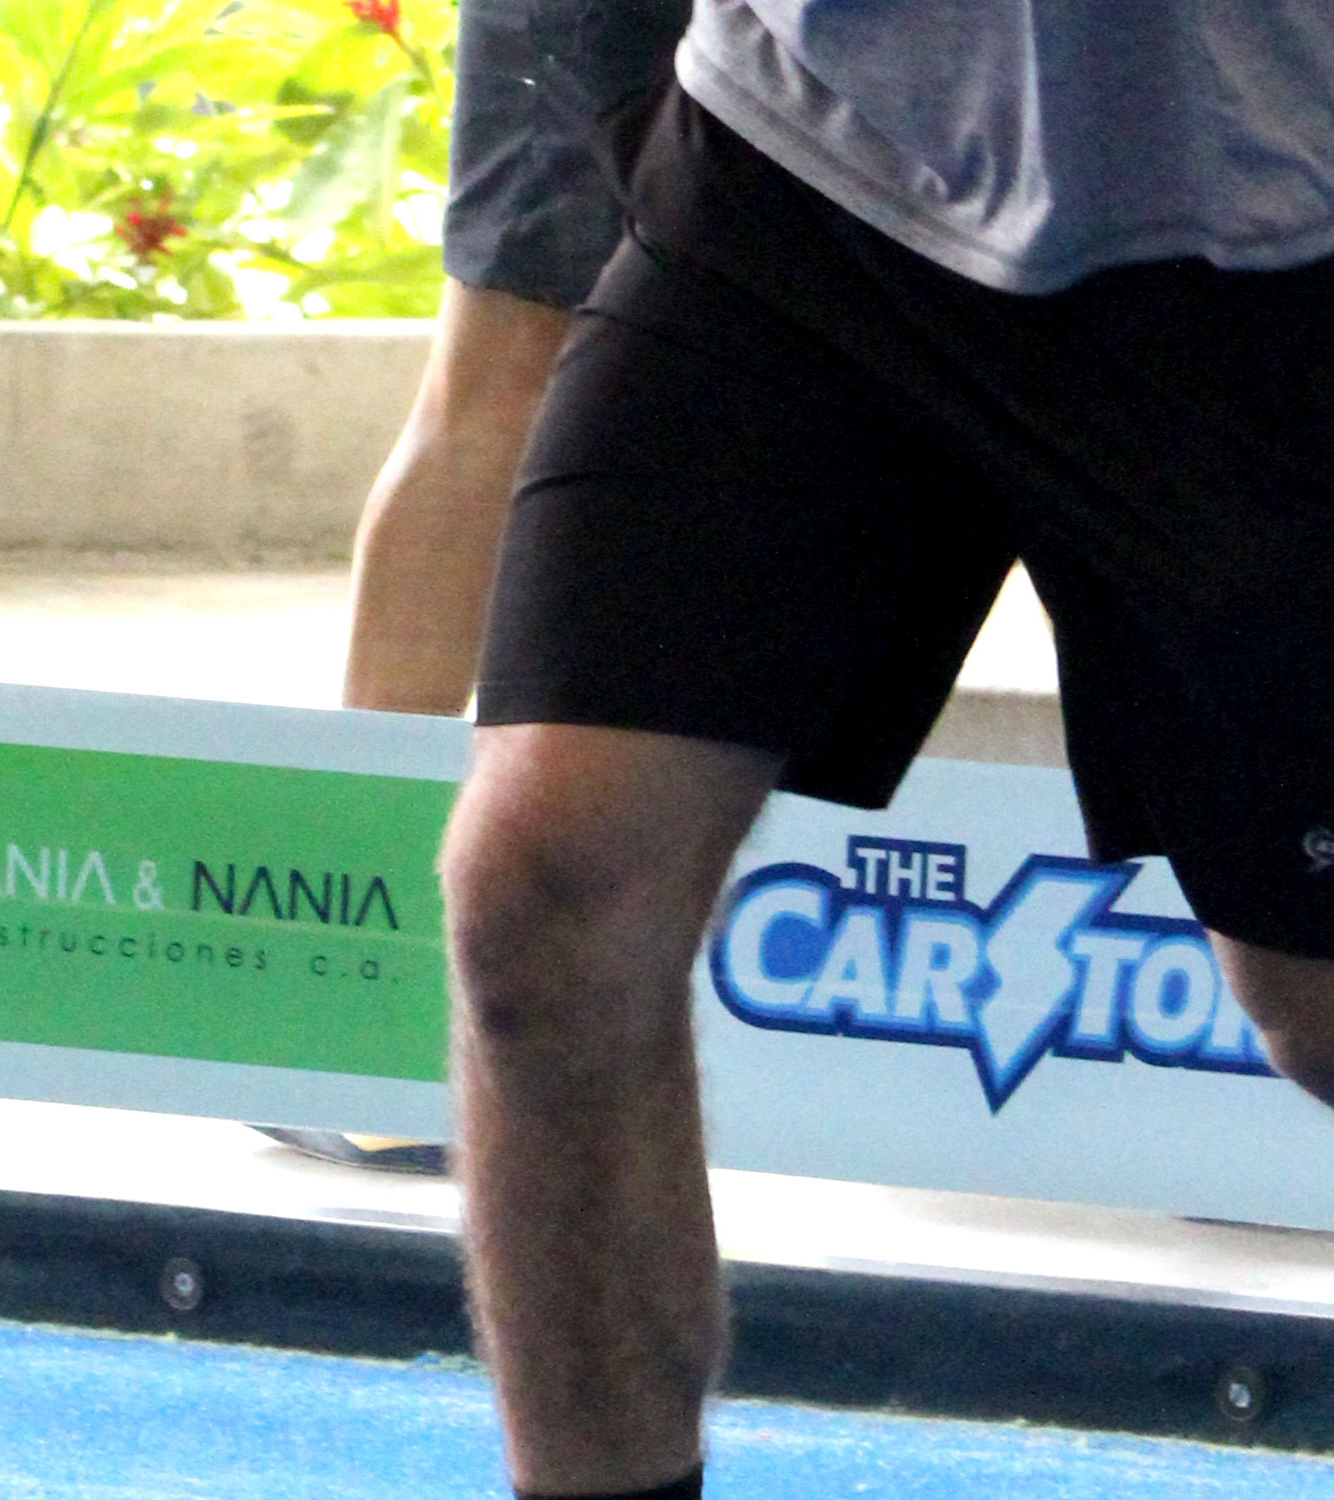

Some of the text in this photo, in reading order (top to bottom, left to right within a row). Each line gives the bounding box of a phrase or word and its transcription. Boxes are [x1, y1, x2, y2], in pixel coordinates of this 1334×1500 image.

[133, 859, 165, 911] &
[191, 860, 400, 930] NANIA
[854, 844, 957, 902] THE
